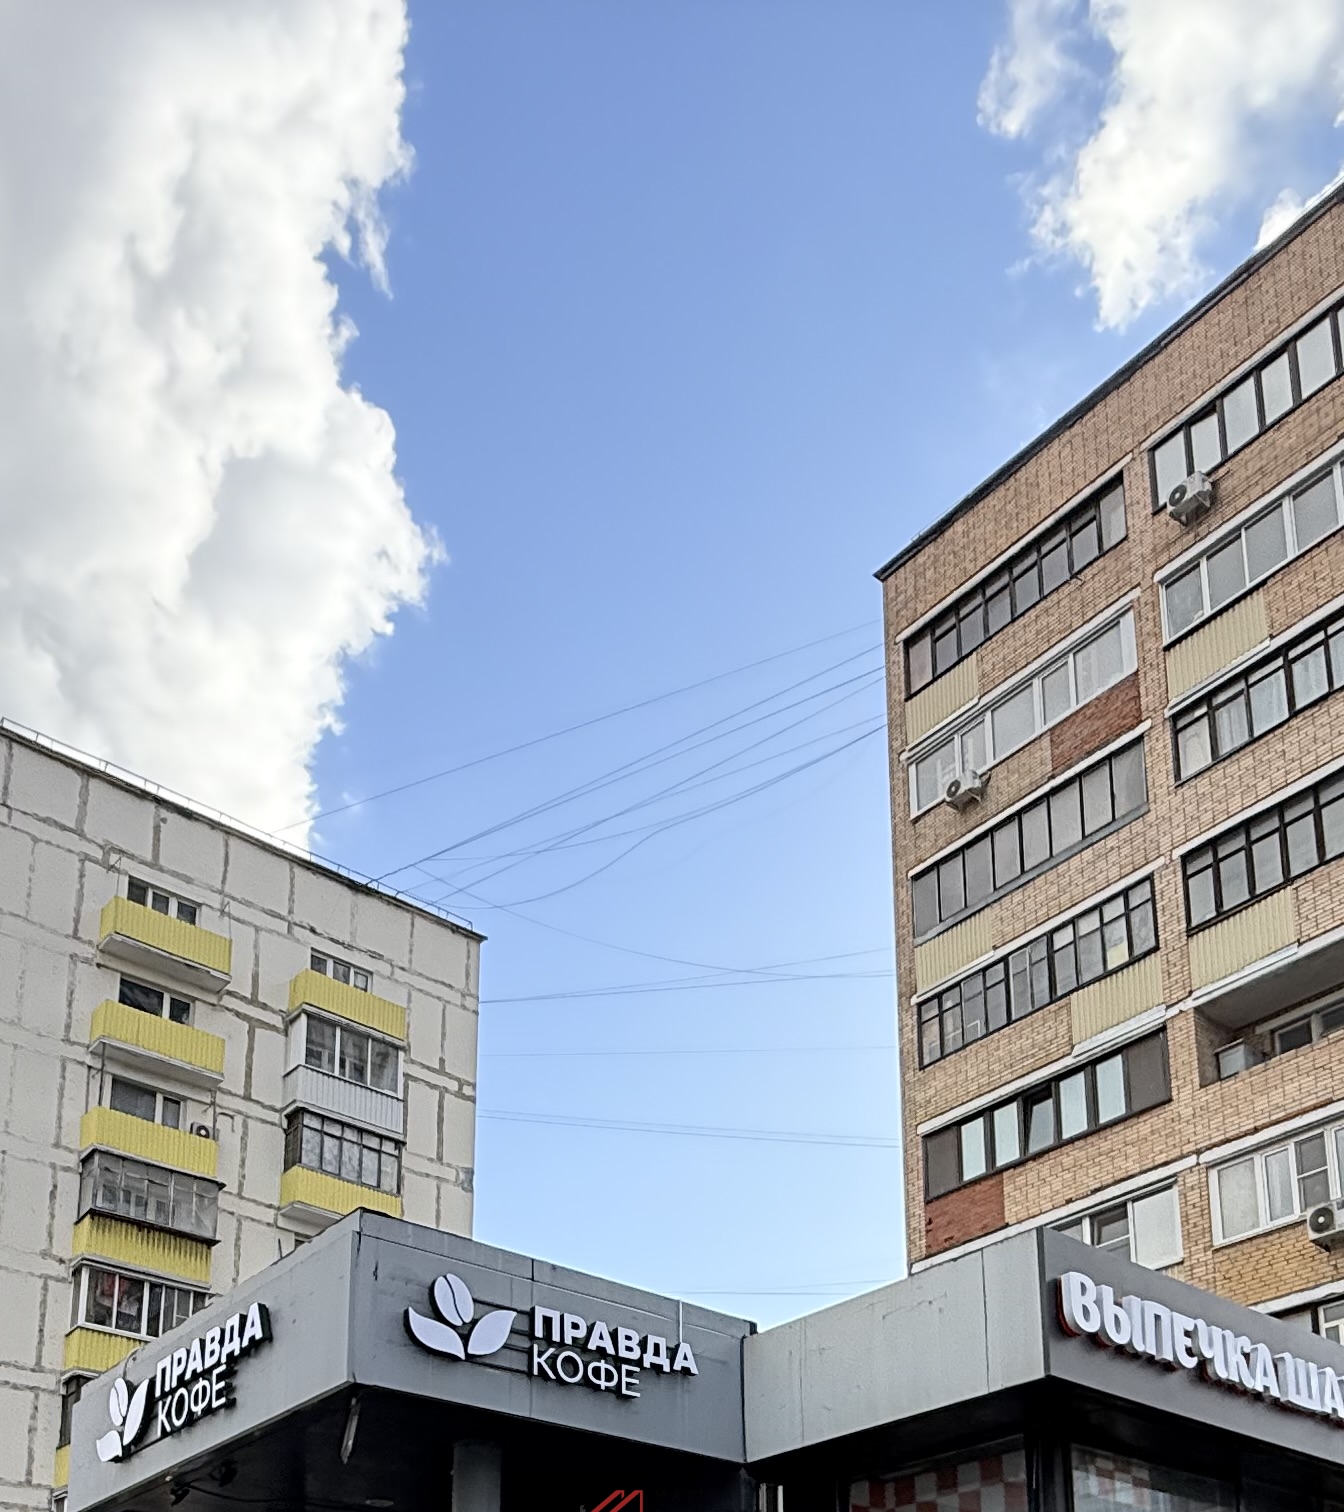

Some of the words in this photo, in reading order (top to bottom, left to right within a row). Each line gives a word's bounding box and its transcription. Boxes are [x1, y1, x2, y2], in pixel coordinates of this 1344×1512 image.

[155, 1302, 264, 1398] ПРАВДА
[533, 1343, 641, 1398] КОФЕ
[534, 1305, 699, 1375] ПРАВДА
[1061, 1272, 1281, 1398] ВЫПЕЧКА
[156, 1364, 227, 1438] КОФЕ
